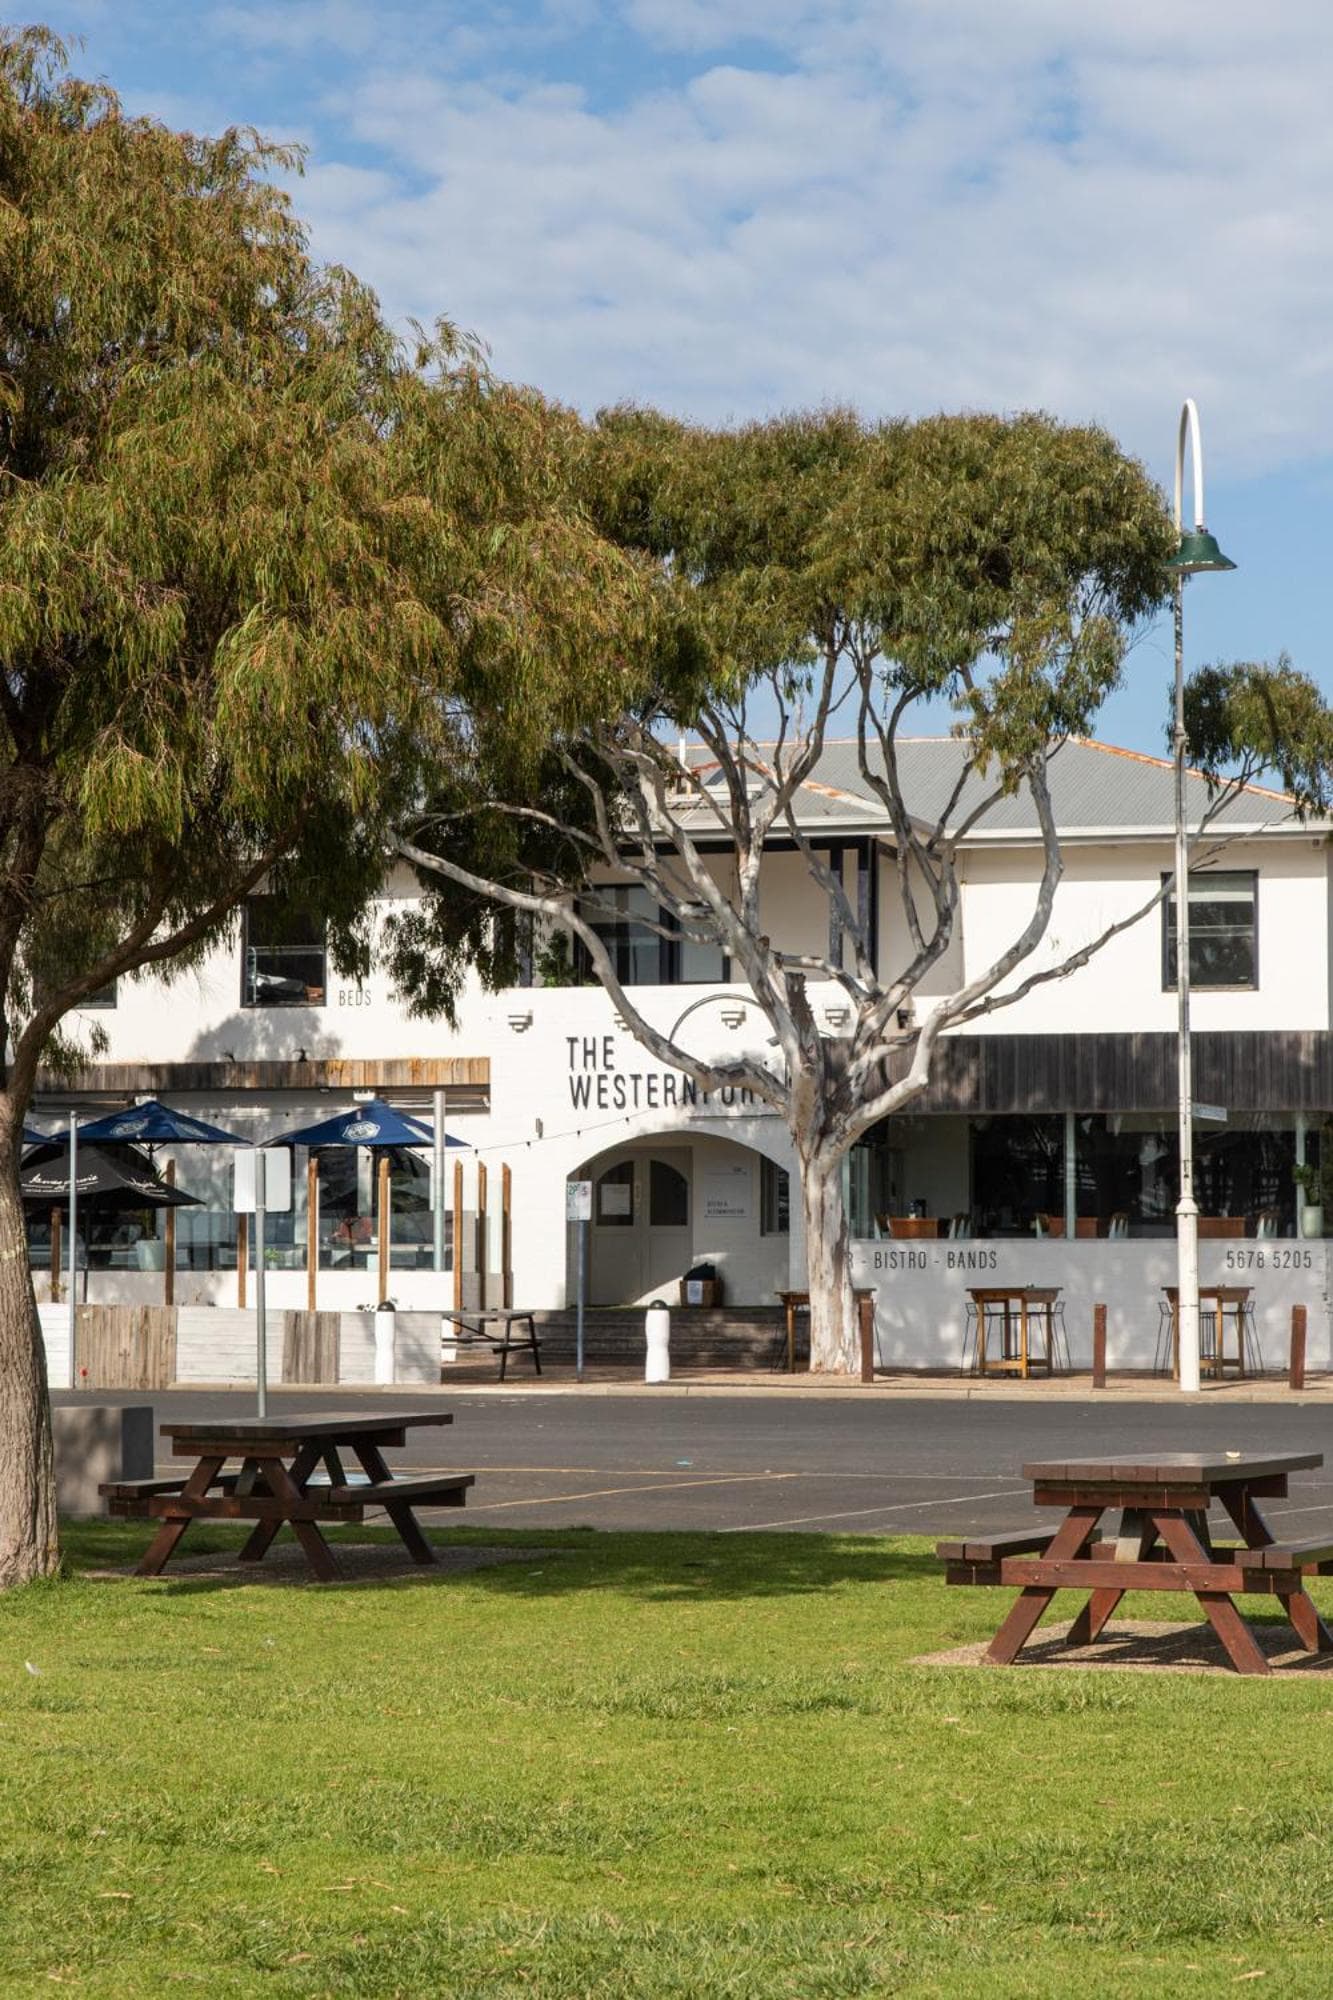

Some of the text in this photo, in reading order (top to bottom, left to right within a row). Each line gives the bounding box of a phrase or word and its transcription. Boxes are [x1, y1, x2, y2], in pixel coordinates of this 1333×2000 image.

[339, 990, 371, 1006] BEDS
[566, 1036, 615, 1071] THE
[569, 1073, 767, 1110] WESTERNO
[874, 1251, 927, 1269] BISTRO
[947, 1251, 997, 1269] BANDS
[1226, 1251, 1312, 1269] 5678 5205
